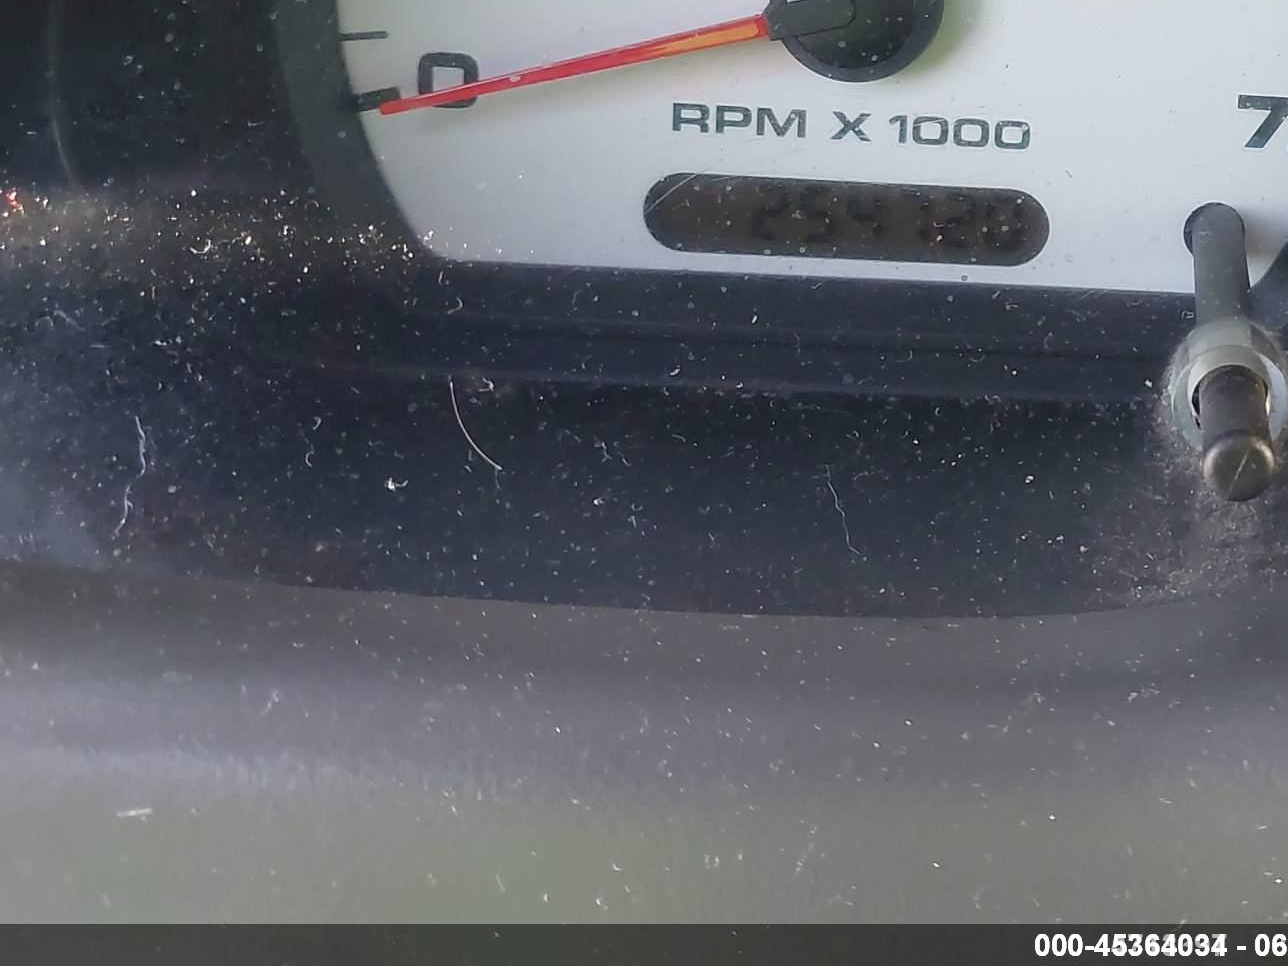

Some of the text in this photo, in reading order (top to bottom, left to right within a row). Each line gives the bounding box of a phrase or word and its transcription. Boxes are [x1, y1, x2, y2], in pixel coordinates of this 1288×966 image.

[418, 52, 479, 109] 0
[671, 101, 1032, 151] RPM X 1000
